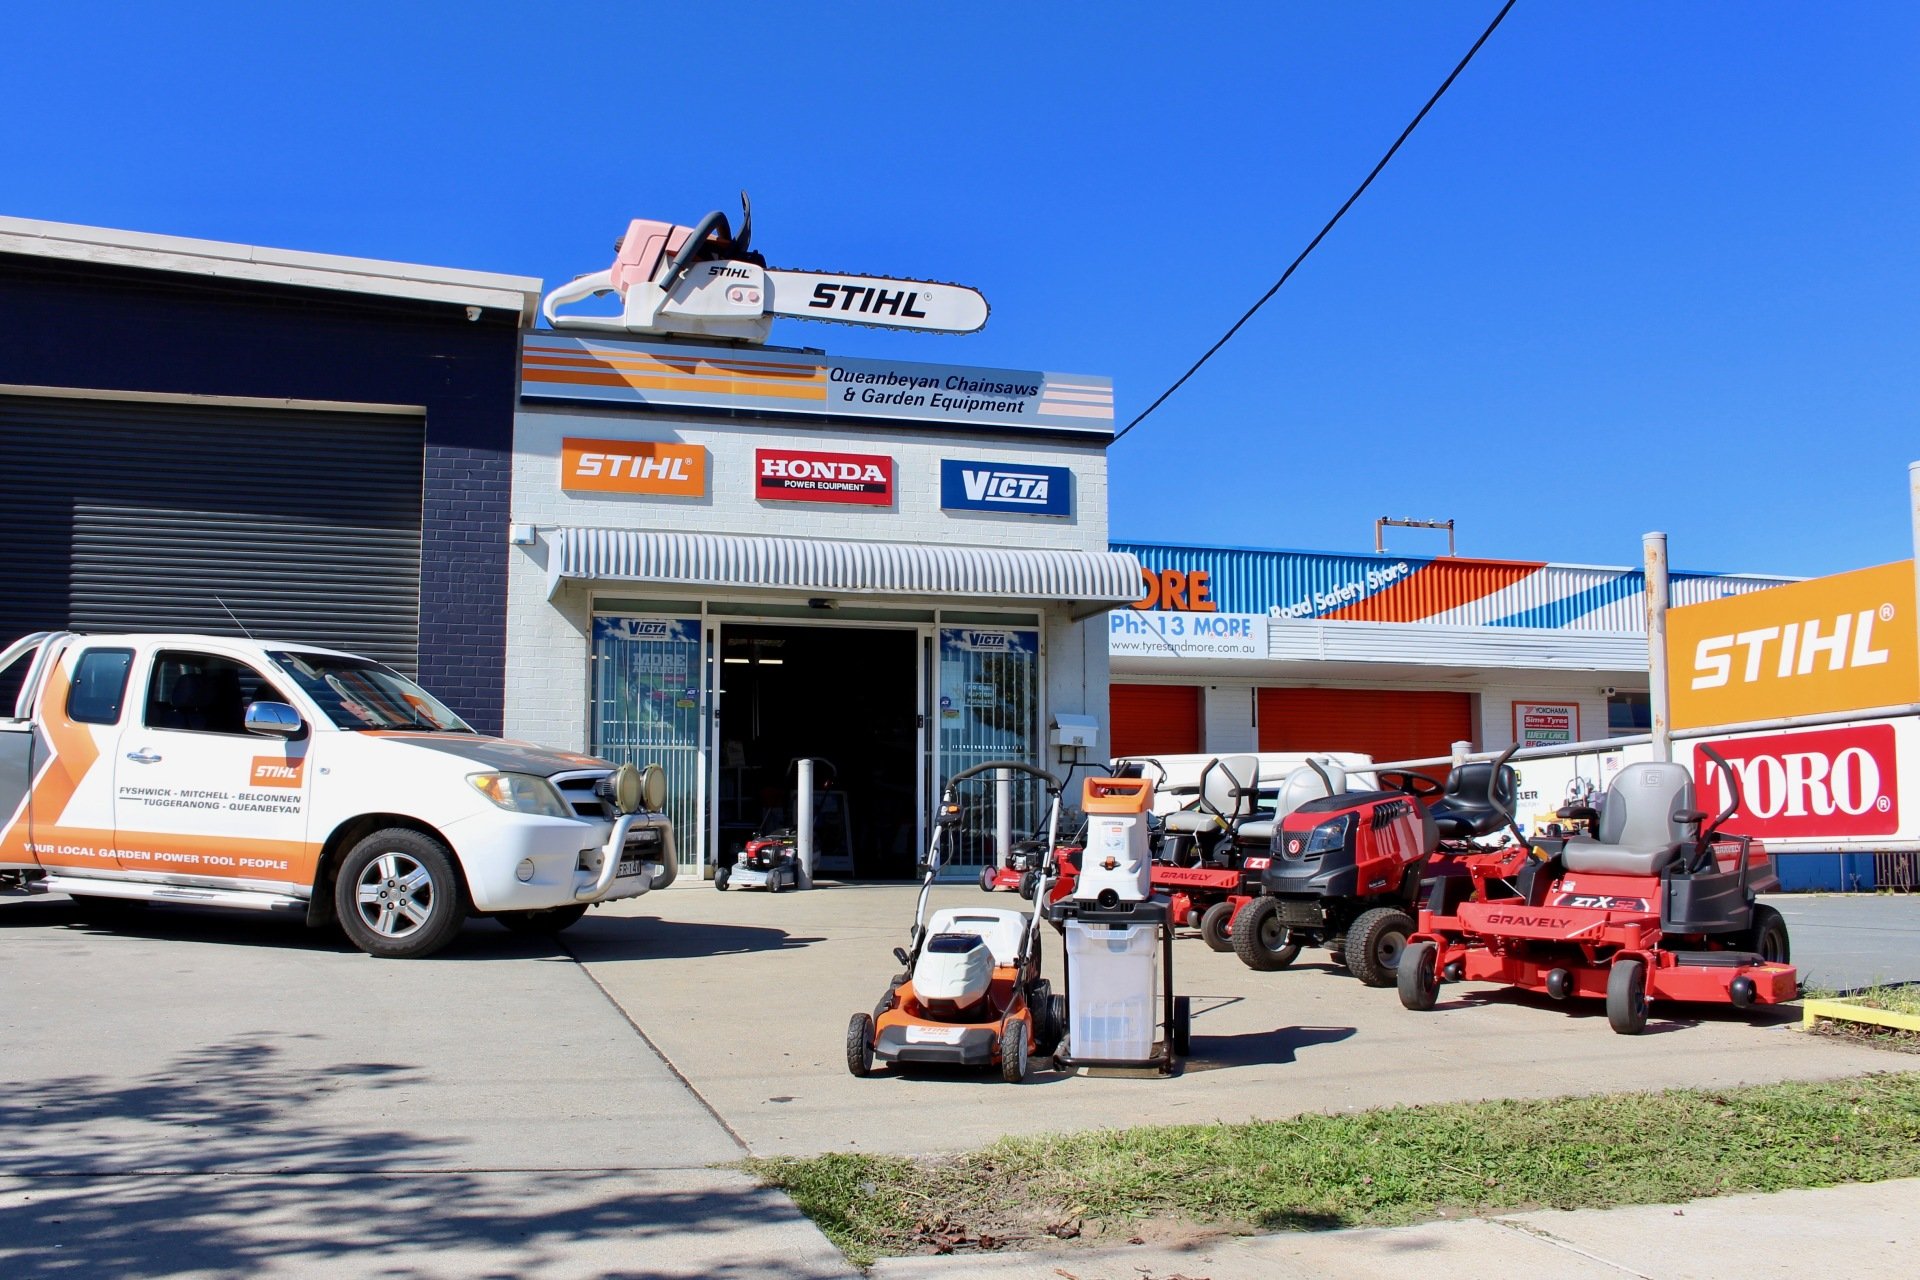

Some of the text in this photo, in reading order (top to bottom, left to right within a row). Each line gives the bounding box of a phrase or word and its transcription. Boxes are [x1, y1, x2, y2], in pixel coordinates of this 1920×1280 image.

[708, 266, 750, 279] STIHL
[808, 282, 927, 319] STIHL
[829, 366, 1039, 397] Queanbeyan Chainsaws
[843, 387, 1025, 414] & Garden Equipment
[575, 453, 691, 481] STIHL
[761, 458, 887, 482] HONDA
[784, 479, 865, 492] POWER EQUIPMENT
[961, 470, 1049, 504] VICTA
[1269, 561, 1409, 619] Road Safety Store
[628, 621, 667, 636] VICTA
[1110, 613, 1251, 637] Ph: 13 MORE
[969, 632, 1005, 647] VICTA
[1111, 640, 1256, 654] www.tyresandmore.com.au
[1691, 609, 1889, 690] STIHL
[1547, 716, 1568, 724] Tyres
[255, 765, 297, 779] STIHL
[1706, 747, 1880, 819] TORO
[119, 787, 301, 804] FYSHWICK MITCHELL BELCONNEN
[143, 798, 301, 814] TUGGERANONG QUEANBEYAN
[23, 842, 288, 870] YOUR LOCAL GARDEN POWER TOOL PEOPLE
[1714, 844, 1742, 854] GRAVELY
[1160, 871, 1213, 882] GRAVELY
[1487, 914, 1573, 929] GRAVELY
